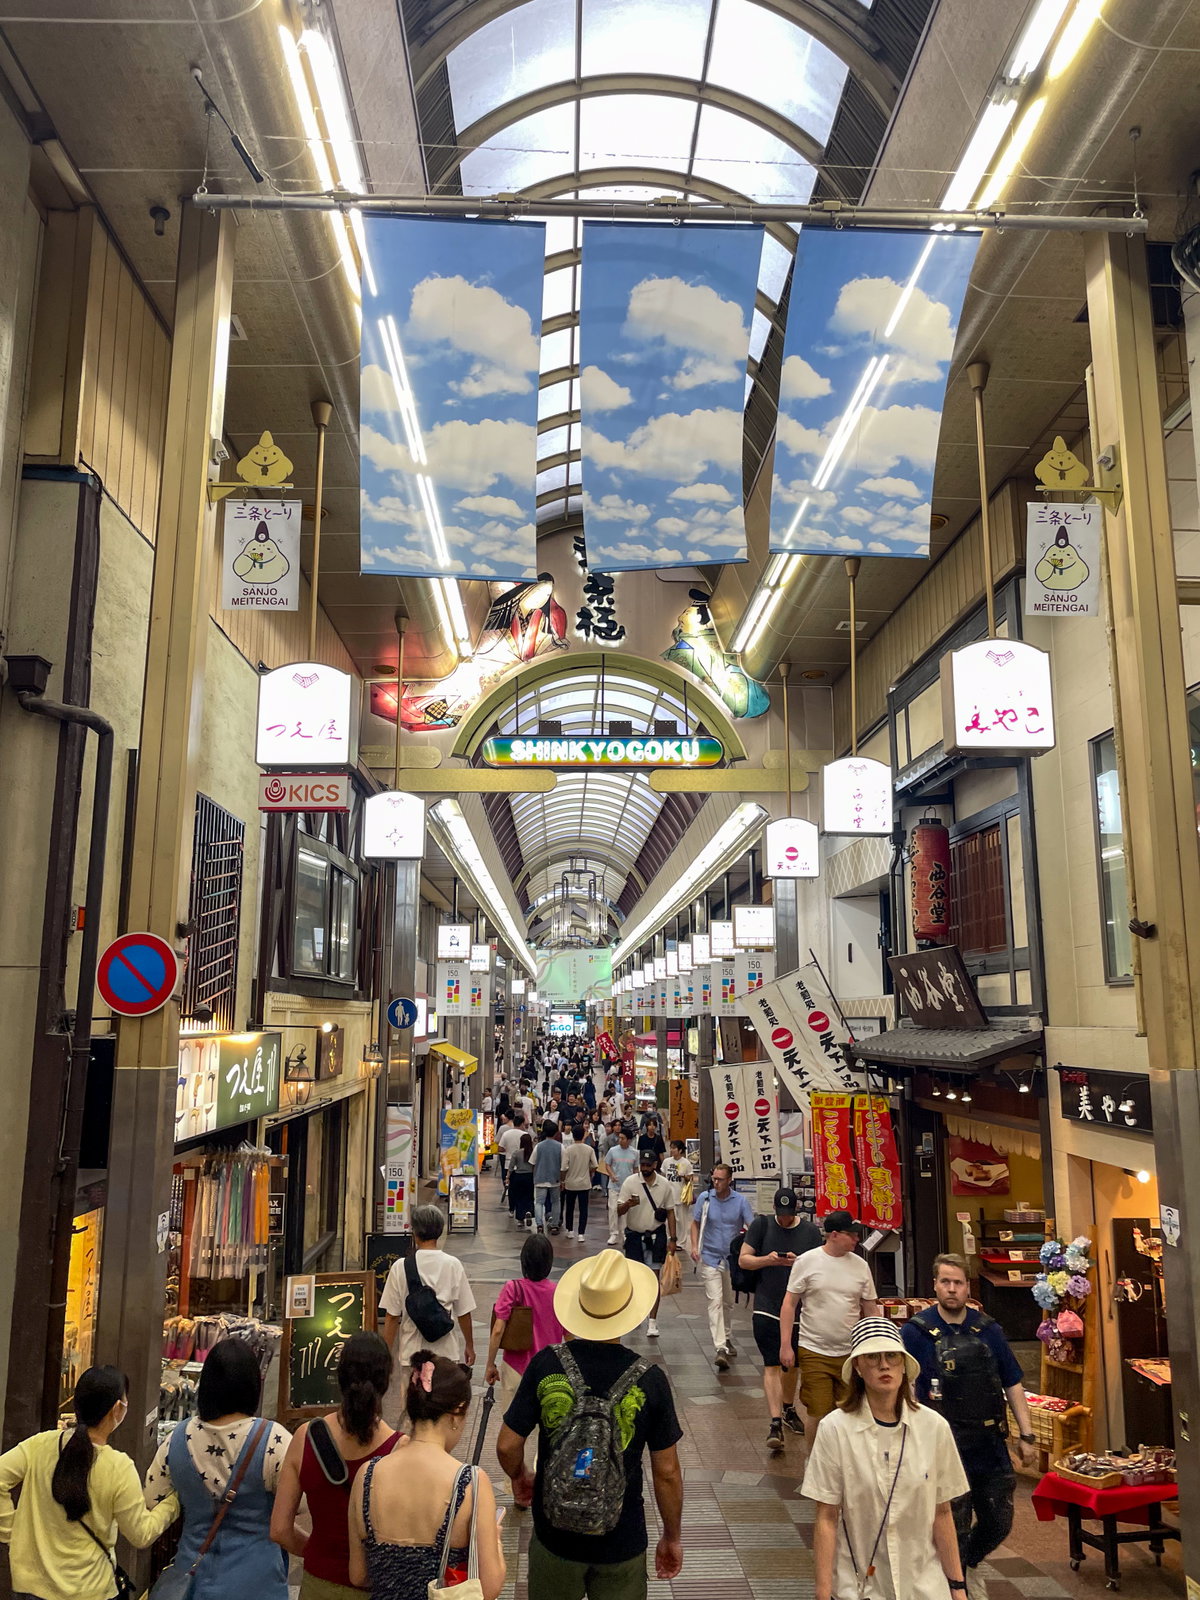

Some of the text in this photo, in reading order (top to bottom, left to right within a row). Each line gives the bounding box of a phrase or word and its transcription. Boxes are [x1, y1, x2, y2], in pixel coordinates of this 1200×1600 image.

[242, 587, 278, 596] SANJO
[1043, 594, 1078, 602] SANJO
[231, 597, 288, 606] MEITENGAI
[1033, 604, 1089, 612] MEITENGAI
[509, 740, 700, 762] SHINKYOGOKU
[288, 784, 340, 802] KICS
[929, 861, 947, 924] 西谷堂
[1078, 1085, 1138, 1126] 美やこ
[728, 1121, 745, 1173] 天下一品
[757, 1118, 777, 1170] 天下一品
[388, 1167, 403, 1177] 150
